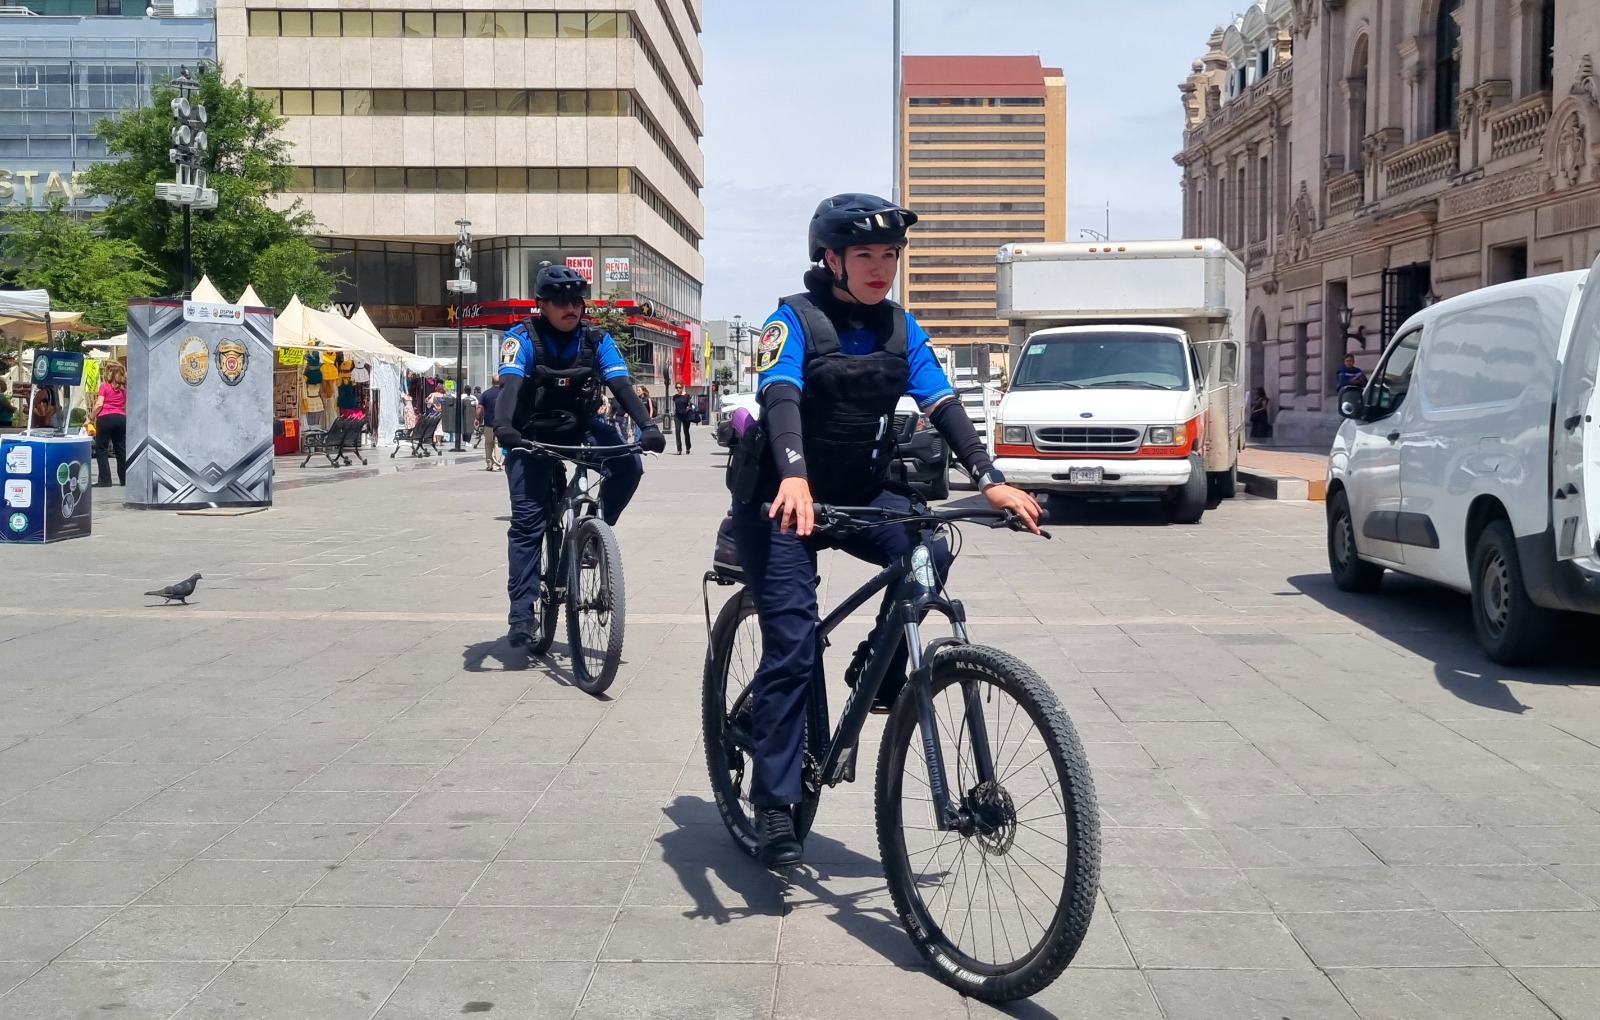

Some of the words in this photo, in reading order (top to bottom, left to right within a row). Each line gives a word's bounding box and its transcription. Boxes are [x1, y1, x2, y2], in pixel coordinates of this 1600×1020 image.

[567, 258, 592, 268] RENTO
[605, 262, 629, 271] RENTA
[956, 661, 1006, 684] MAXXIS
